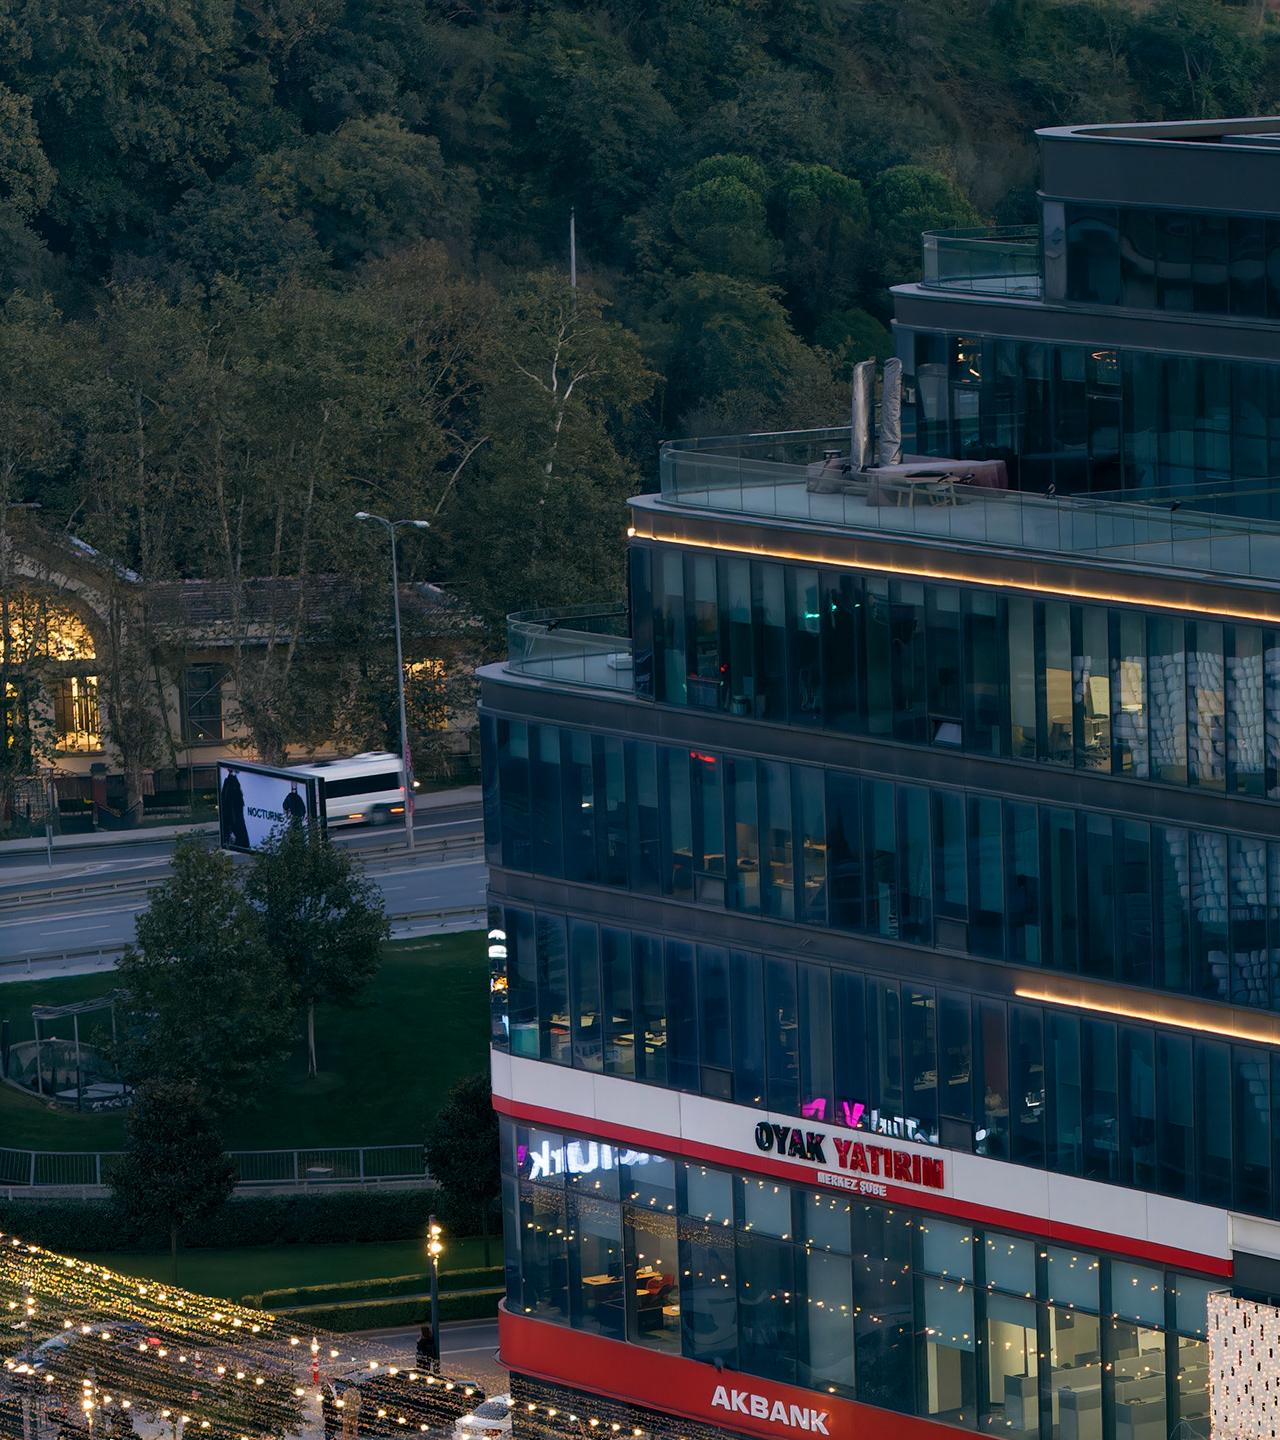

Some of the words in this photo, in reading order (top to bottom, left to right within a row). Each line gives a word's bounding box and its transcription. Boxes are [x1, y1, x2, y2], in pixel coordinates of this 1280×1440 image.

[754, 1121, 827, 1164] OYAK
[833, 1137, 944, 1190] YATIRIM
[817, 1171, 858, 1191] MERKEZ
[710, 1384, 830, 1437] AKBANK
